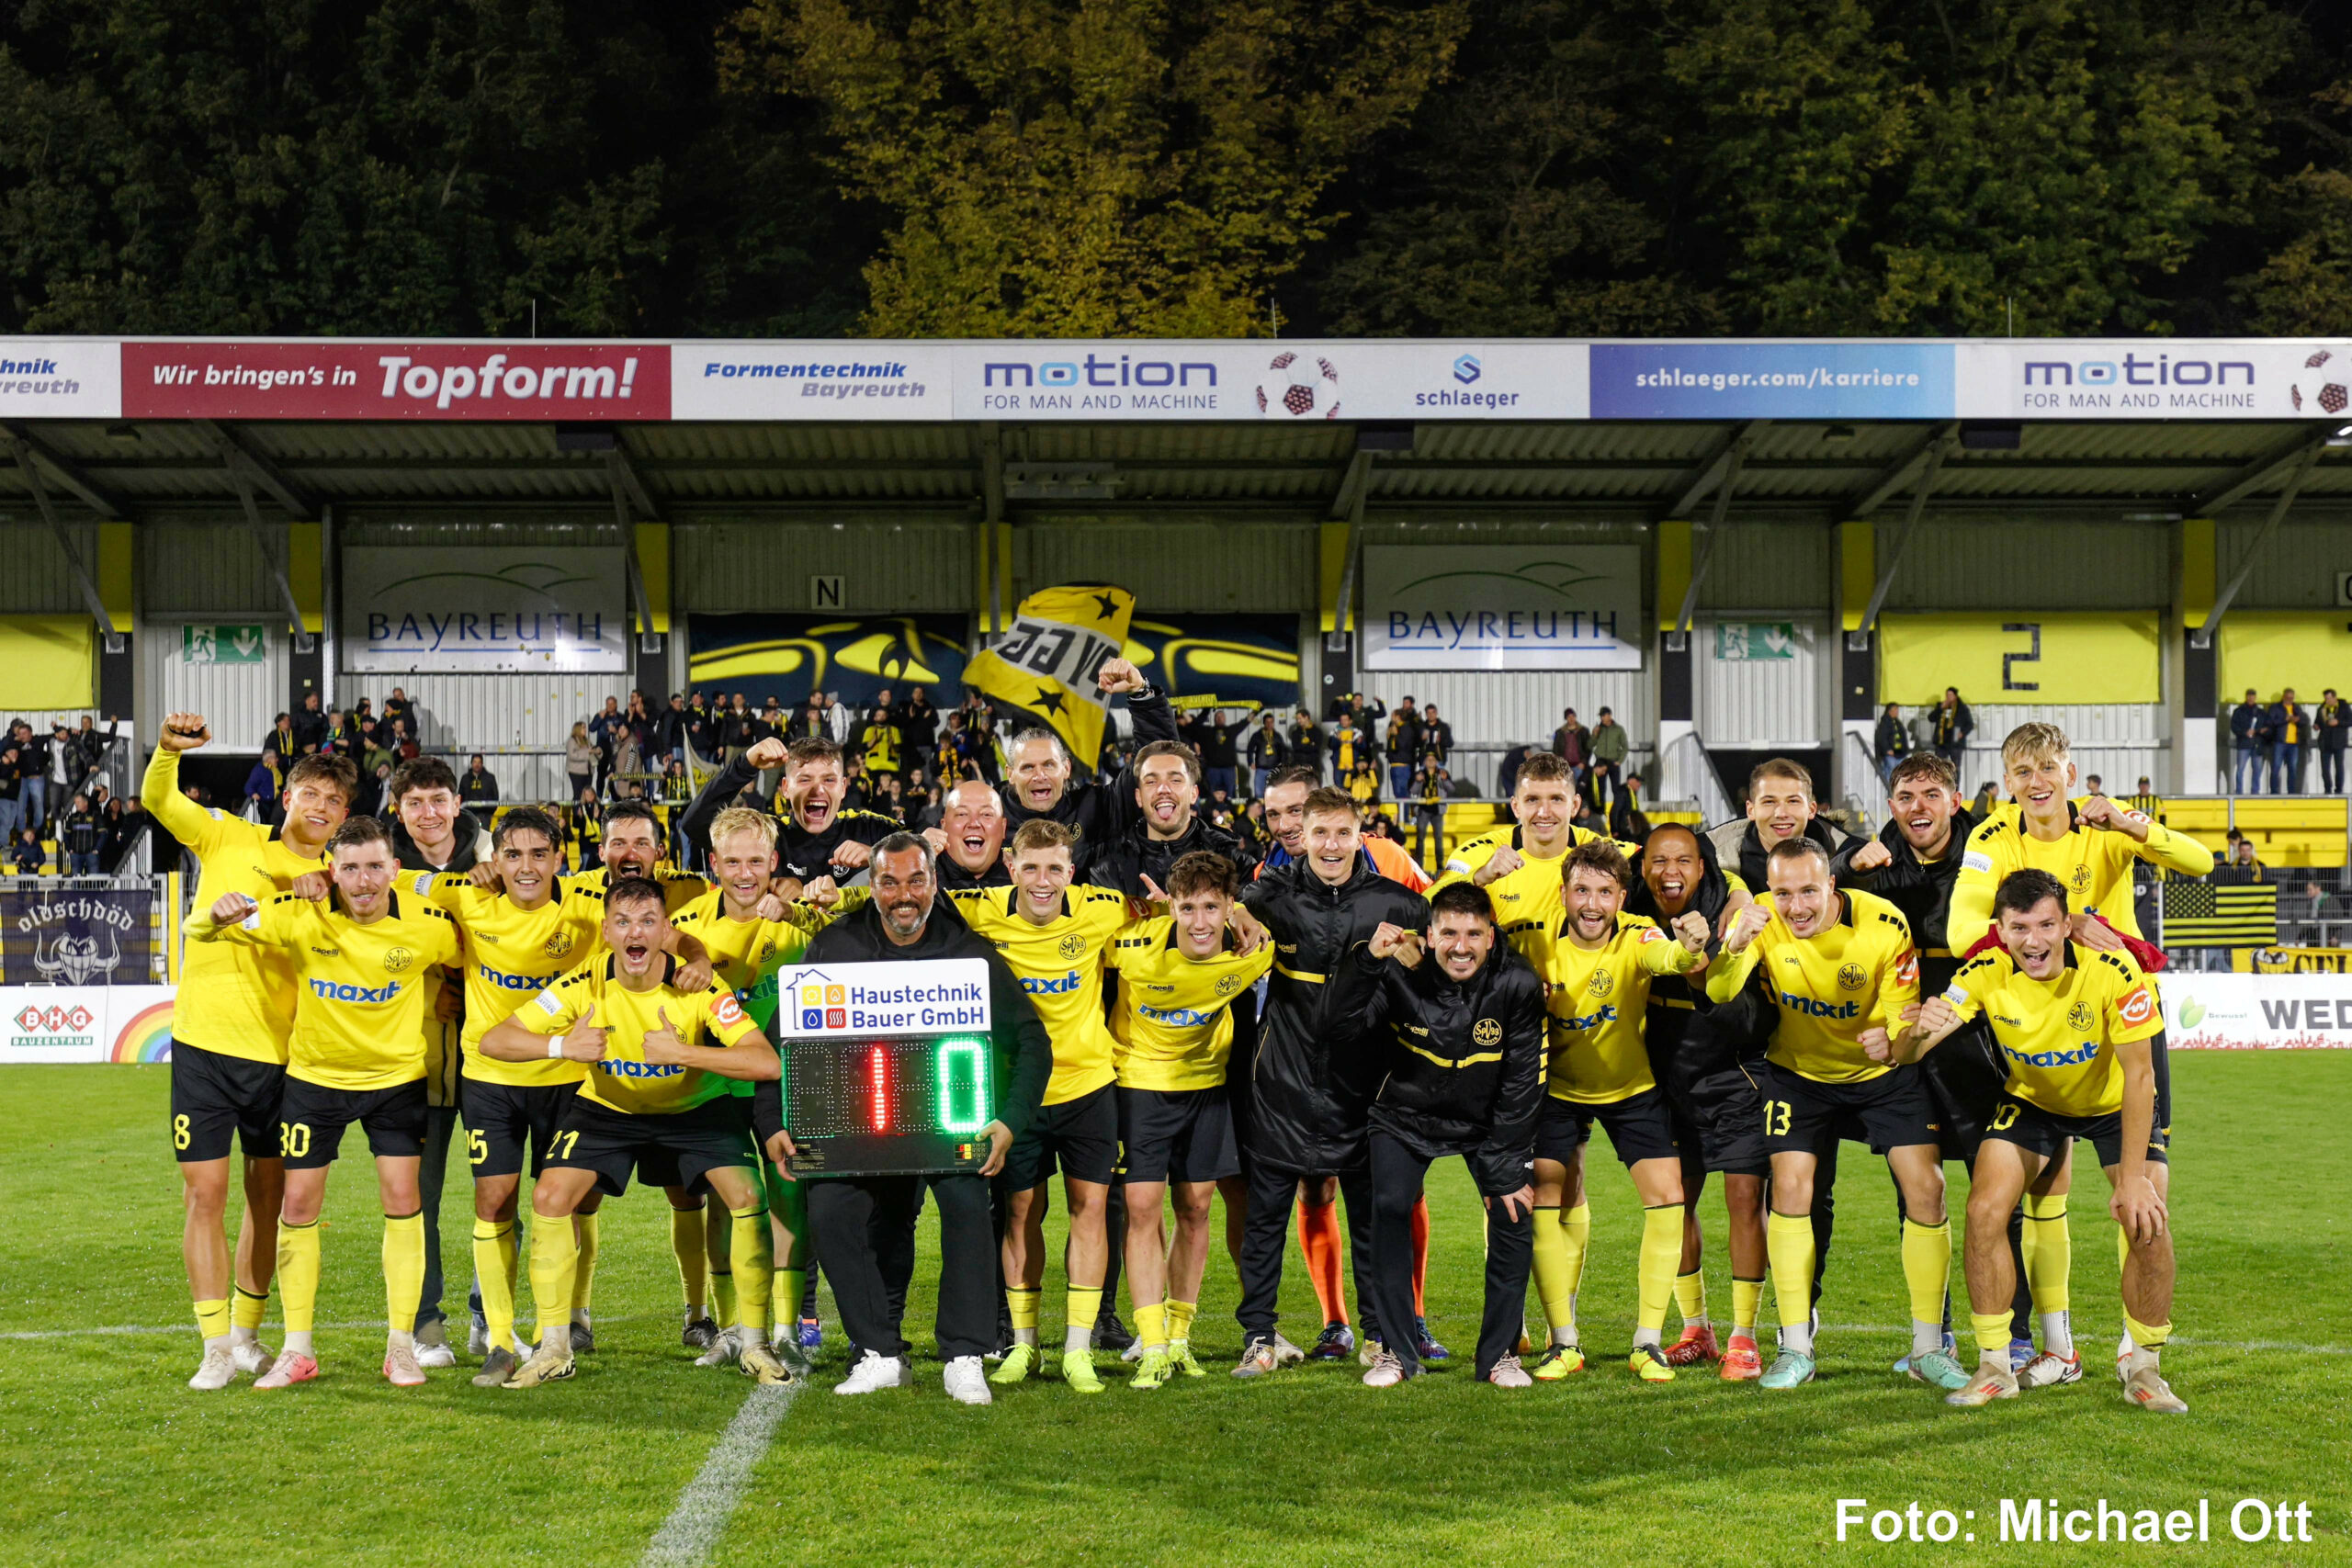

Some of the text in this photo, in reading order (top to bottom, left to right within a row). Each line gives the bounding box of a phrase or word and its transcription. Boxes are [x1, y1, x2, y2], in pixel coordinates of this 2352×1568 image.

[153, 354, 639, 410] Wir bringen's in Topform!
[704, 362, 907, 378] Formentechnik
[984, 354, 1217, 387] motion
[1636, 367, 1919, 390] schlaeger.com/karriere
[2024, 353, 2255, 385] motion
[801, 382, 926, 400] Bayreuth
[984, 395, 1217, 409] FOR MAN AND MACHINE
[1416, 389, 1519, 410] schlaeger
[2024, 393, 2255, 408] FOR MAN AND MACHINE
[818, 579, 838, 605] N
[368, 612, 602, 651] BAYREUTH
[1389, 611, 1617, 650] BAYREUTH
[2002, 623, 2041, 691] 2
[309, 977, 402, 1003] maxit
[851, 983, 982, 1005] Haustechnik
[853, 1006, 984, 1028] Bauer GmbH
[1994, 1014, 2021, 1026] capelli
[13, 1037, 92, 1045] BAUZENTRUM
[2003, 1041, 2099, 1067] maxit
[938, 1040, 987, 1134] 0
[1763, 1100, 1792, 1136] 13
[175, 1113, 191, 1150] 8
[546, 1130, 580, 1159] 21
